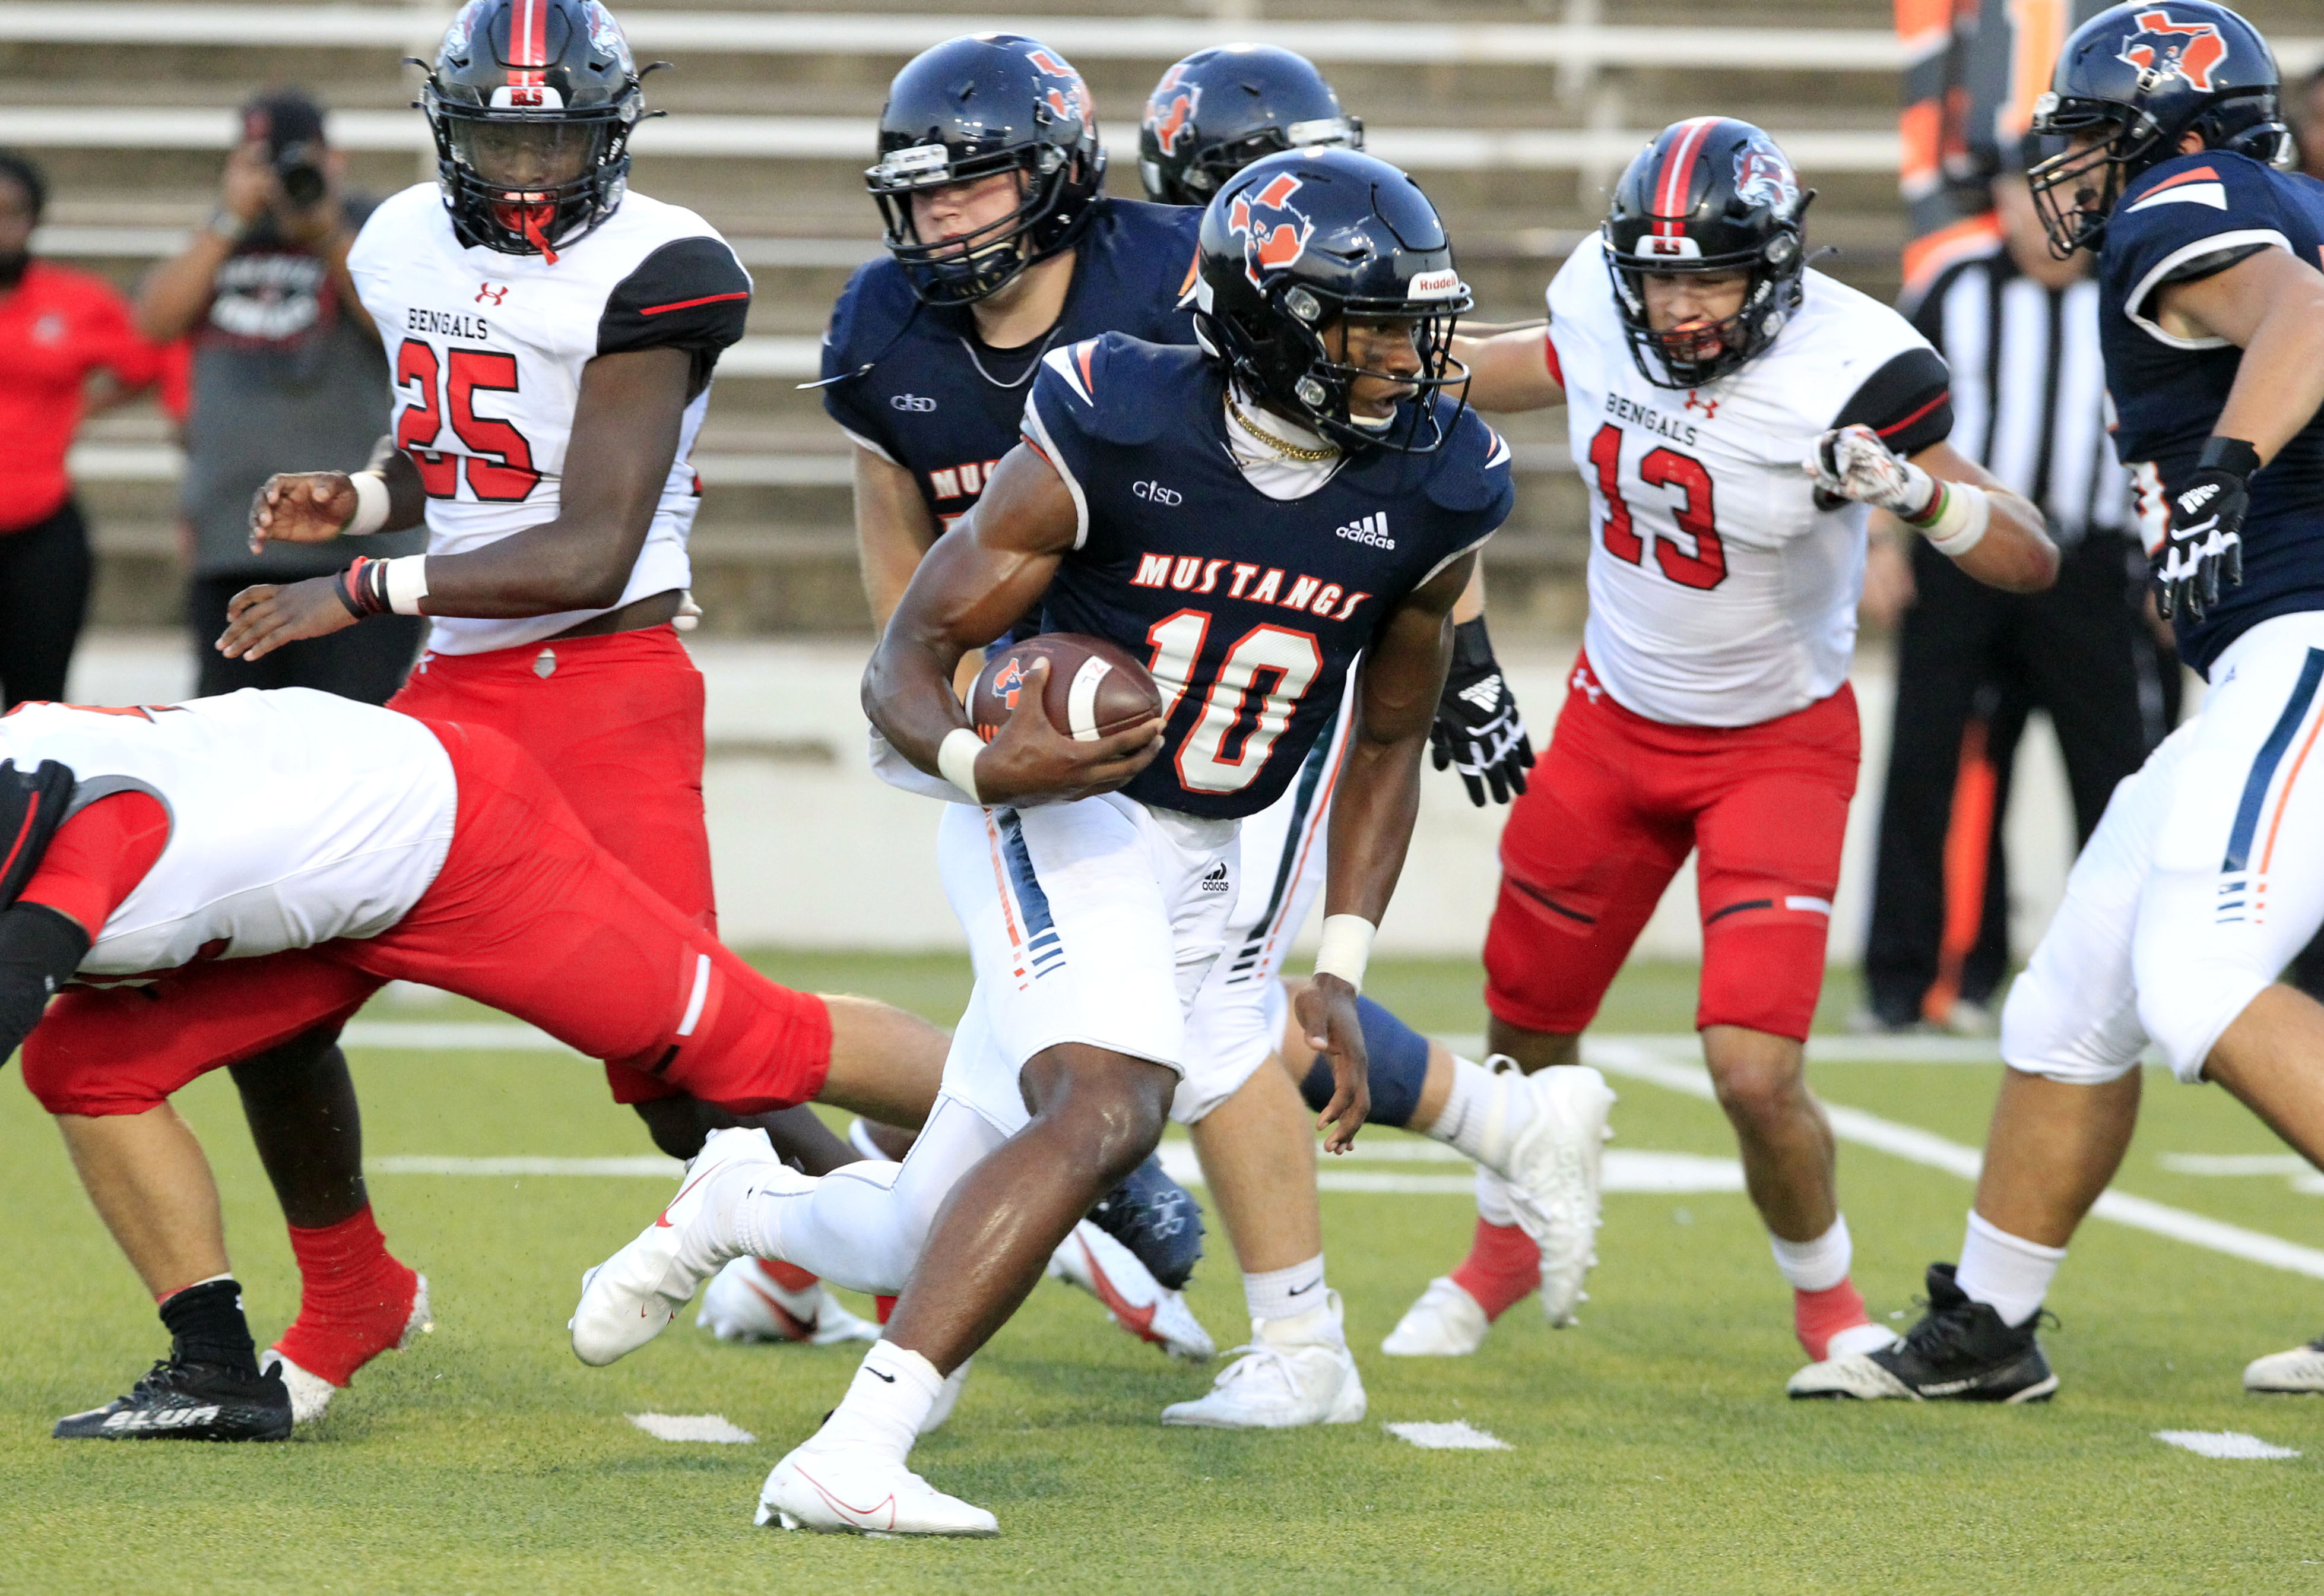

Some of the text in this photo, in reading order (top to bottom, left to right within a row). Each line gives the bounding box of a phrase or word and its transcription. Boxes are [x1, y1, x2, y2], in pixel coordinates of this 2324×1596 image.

[1420, 275, 1456, 291] Riddell
[408, 308, 488, 340] BENGALS
[397, 336, 541, 502] 25
[1605, 391, 1697, 446] BENGALS
[1589, 421, 1728, 590] 13
[1336, 526, 1395, 550] adidas
[1129, 552, 1373, 622] MUSTANGS
[1145, 607, 1324, 796] 10
[1202, 881, 1229, 891] adidas
